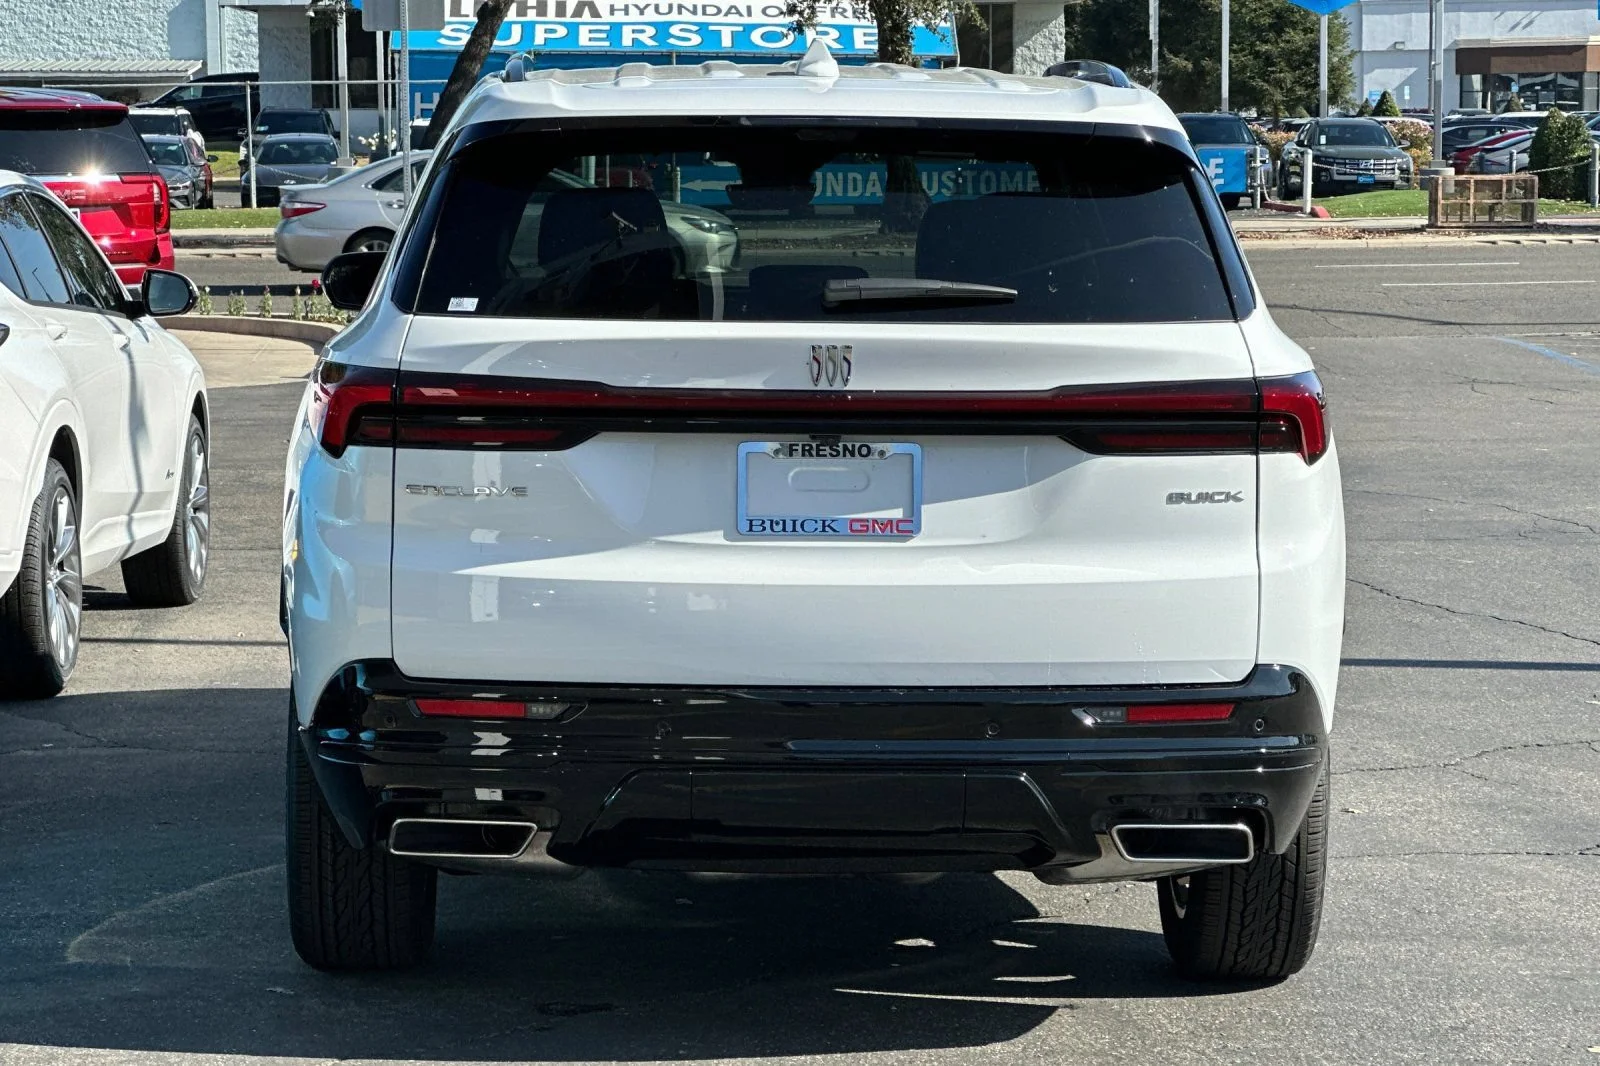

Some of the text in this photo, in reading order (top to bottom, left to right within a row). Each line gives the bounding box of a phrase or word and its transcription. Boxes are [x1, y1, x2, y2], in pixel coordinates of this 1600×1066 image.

[449, 0, 603, 18] LHIA
[610, 2, 752, 18] HYUNDAI
[437, 24, 879, 49] SUPERSTORE
[921, 170, 1042, 195] USTOME
[788, 443, 872, 458] FRESNO
[405, 484, 529, 497] ENCLAVE
[1165, 490, 1245, 505] BUICK
[746, 518, 914, 534] BUICK GMC
